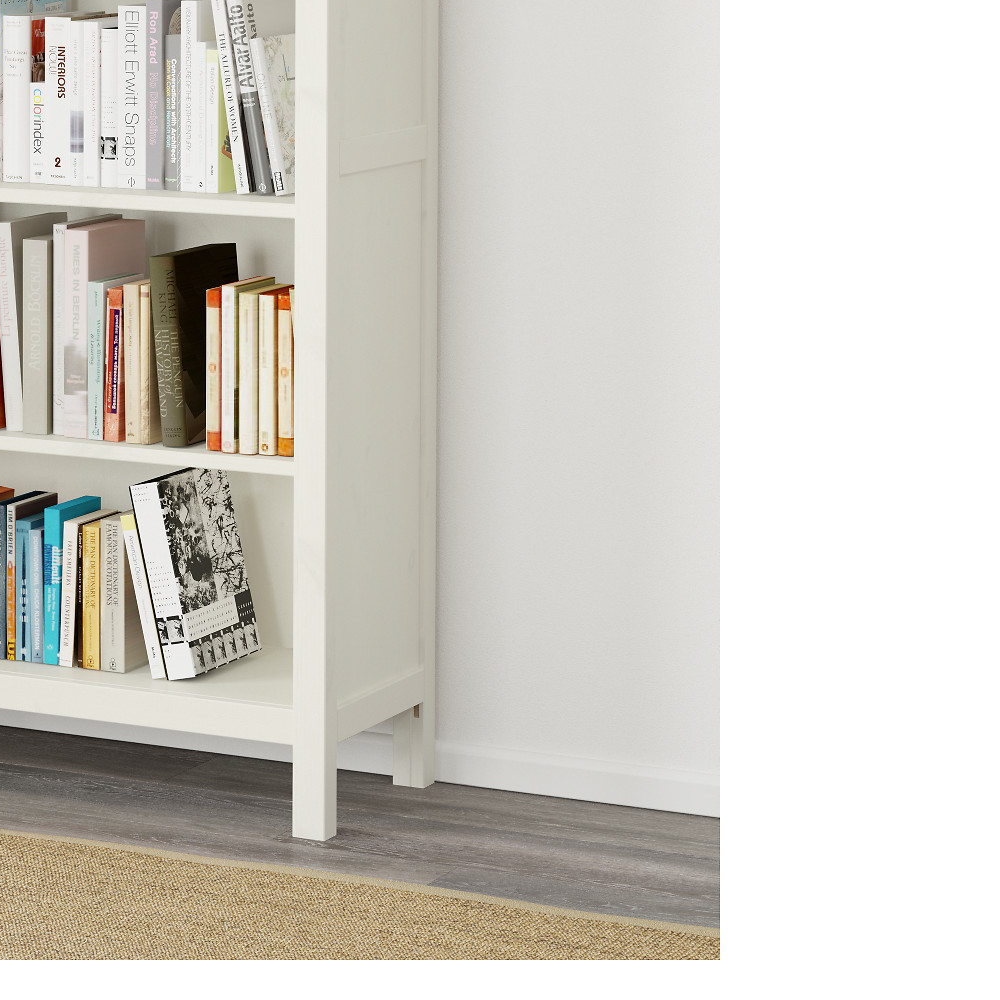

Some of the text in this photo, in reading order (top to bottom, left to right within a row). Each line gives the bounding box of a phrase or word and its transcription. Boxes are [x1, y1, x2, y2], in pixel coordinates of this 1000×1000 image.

[48, 45, 57, 75] NOW!
[57, 46, 66, 99] INTERIORS
[230, 4, 254, 89] Alvar Aalto
[122, 10, 140, 167] Elliott Erwitt Snaps
[147, 11, 159, 146] Ron Arad No Discipline
[32, 88, 44, 154] colorindex
[54, 156, 61, 168] 2
[72, 244, 81, 341] MIES IN BERLIN
[158, 269, 177, 324] MICHAEL KING
[153, 330, 168, 418] NEW ZEALAND
[160, 329, 174, 396] HISTORY of
[169, 330, 183, 408] THE PENGUIN
[51, 545, 61, 585] difficult
[63, 595, 71, 647] COUNTERPUNCH
[89, 599, 96, 609] OF
[112, 596, 119, 607] OF
